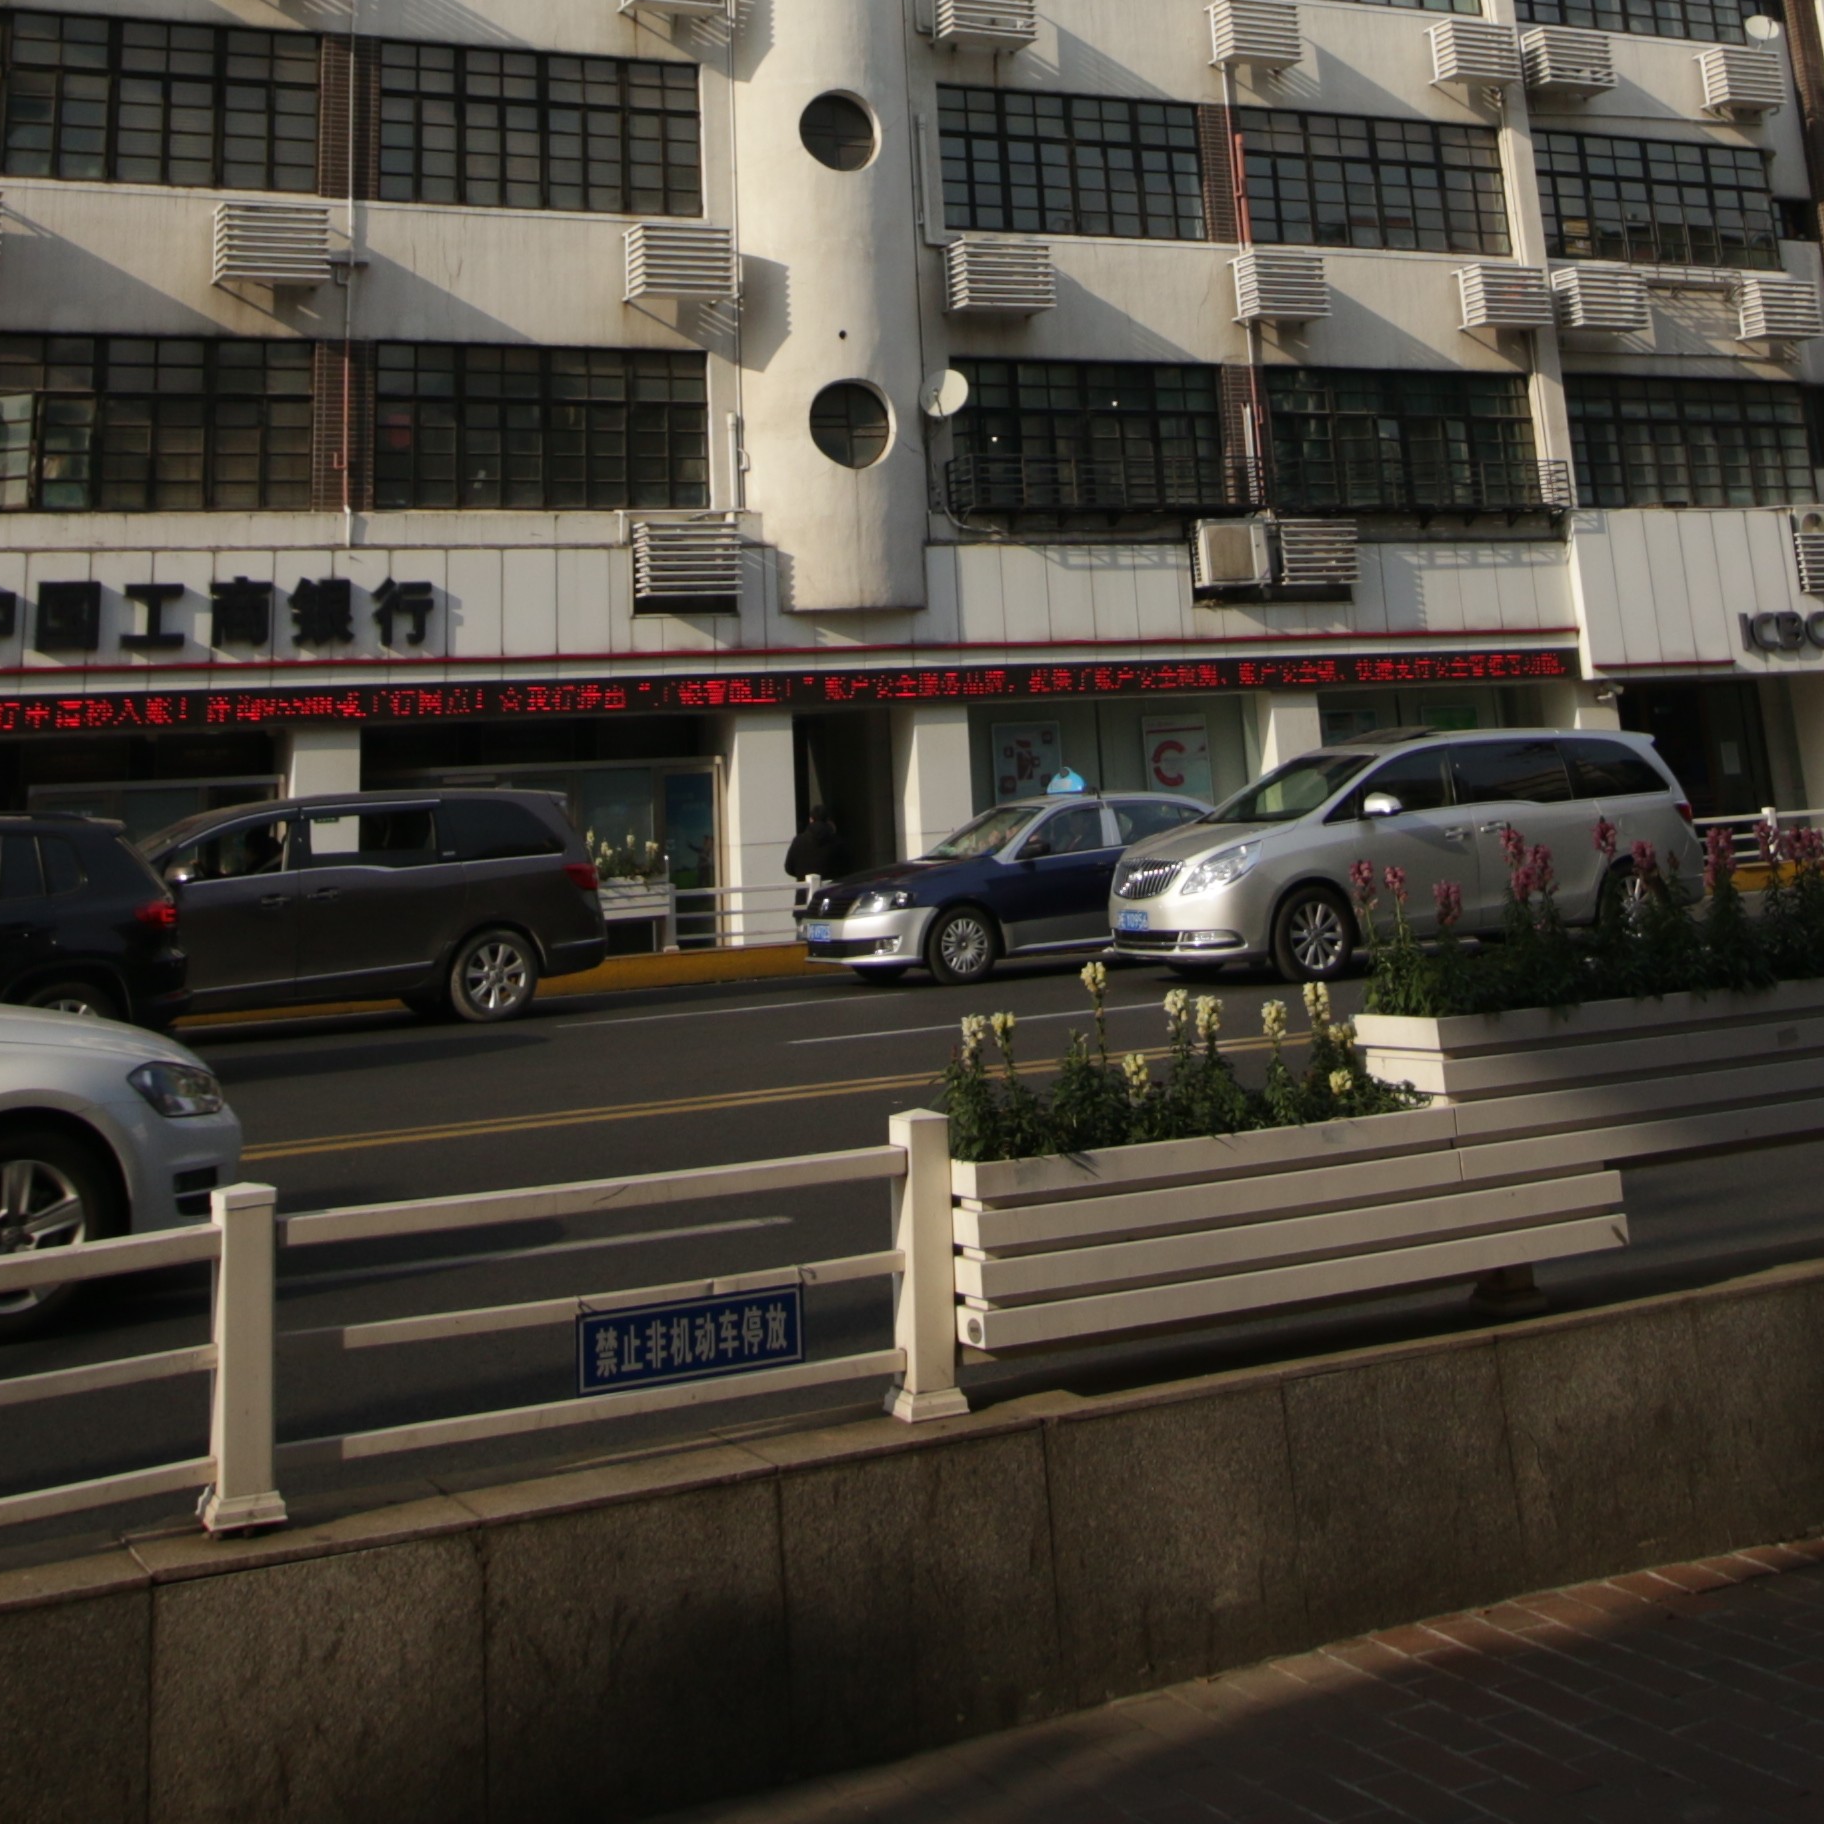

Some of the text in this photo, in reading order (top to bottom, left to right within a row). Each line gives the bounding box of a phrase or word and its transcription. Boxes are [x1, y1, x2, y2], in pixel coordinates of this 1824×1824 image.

[595, 1302, 788, 1379] 禁止非机动车停放
